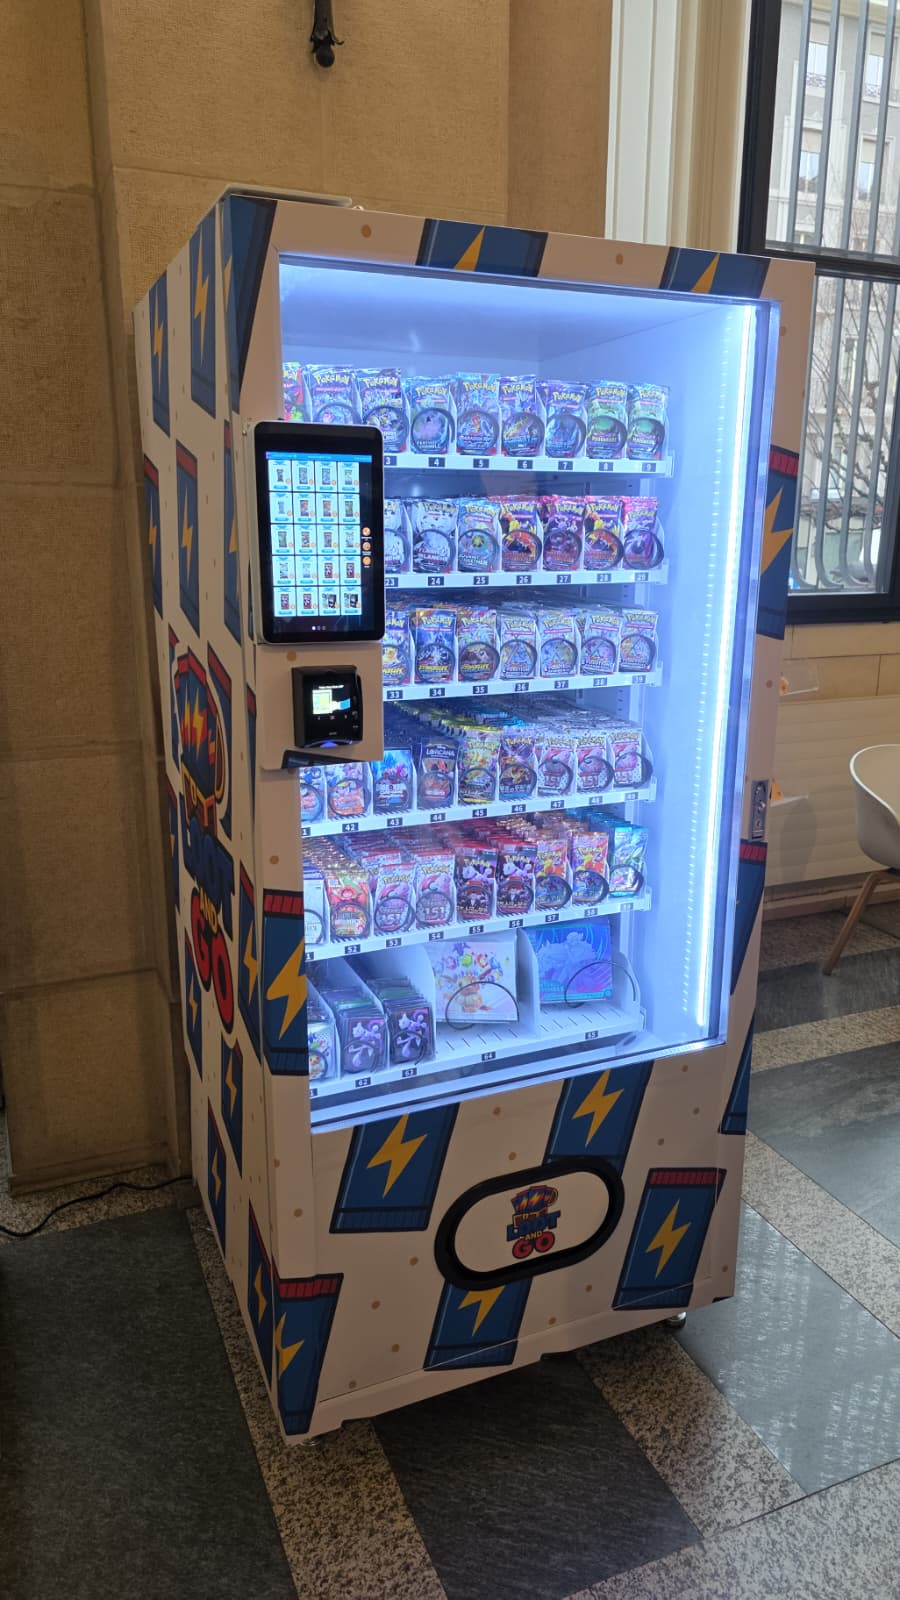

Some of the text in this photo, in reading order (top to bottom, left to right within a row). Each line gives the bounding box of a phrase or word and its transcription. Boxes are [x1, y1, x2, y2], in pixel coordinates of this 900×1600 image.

[384, 577, 395, 586] 23
[199, 886, 218, 937] AND
[190, 887, 235, 1034] GO
[512, 1230, 556, 1259] GO
[524, 1230, 543, 1241] AND
